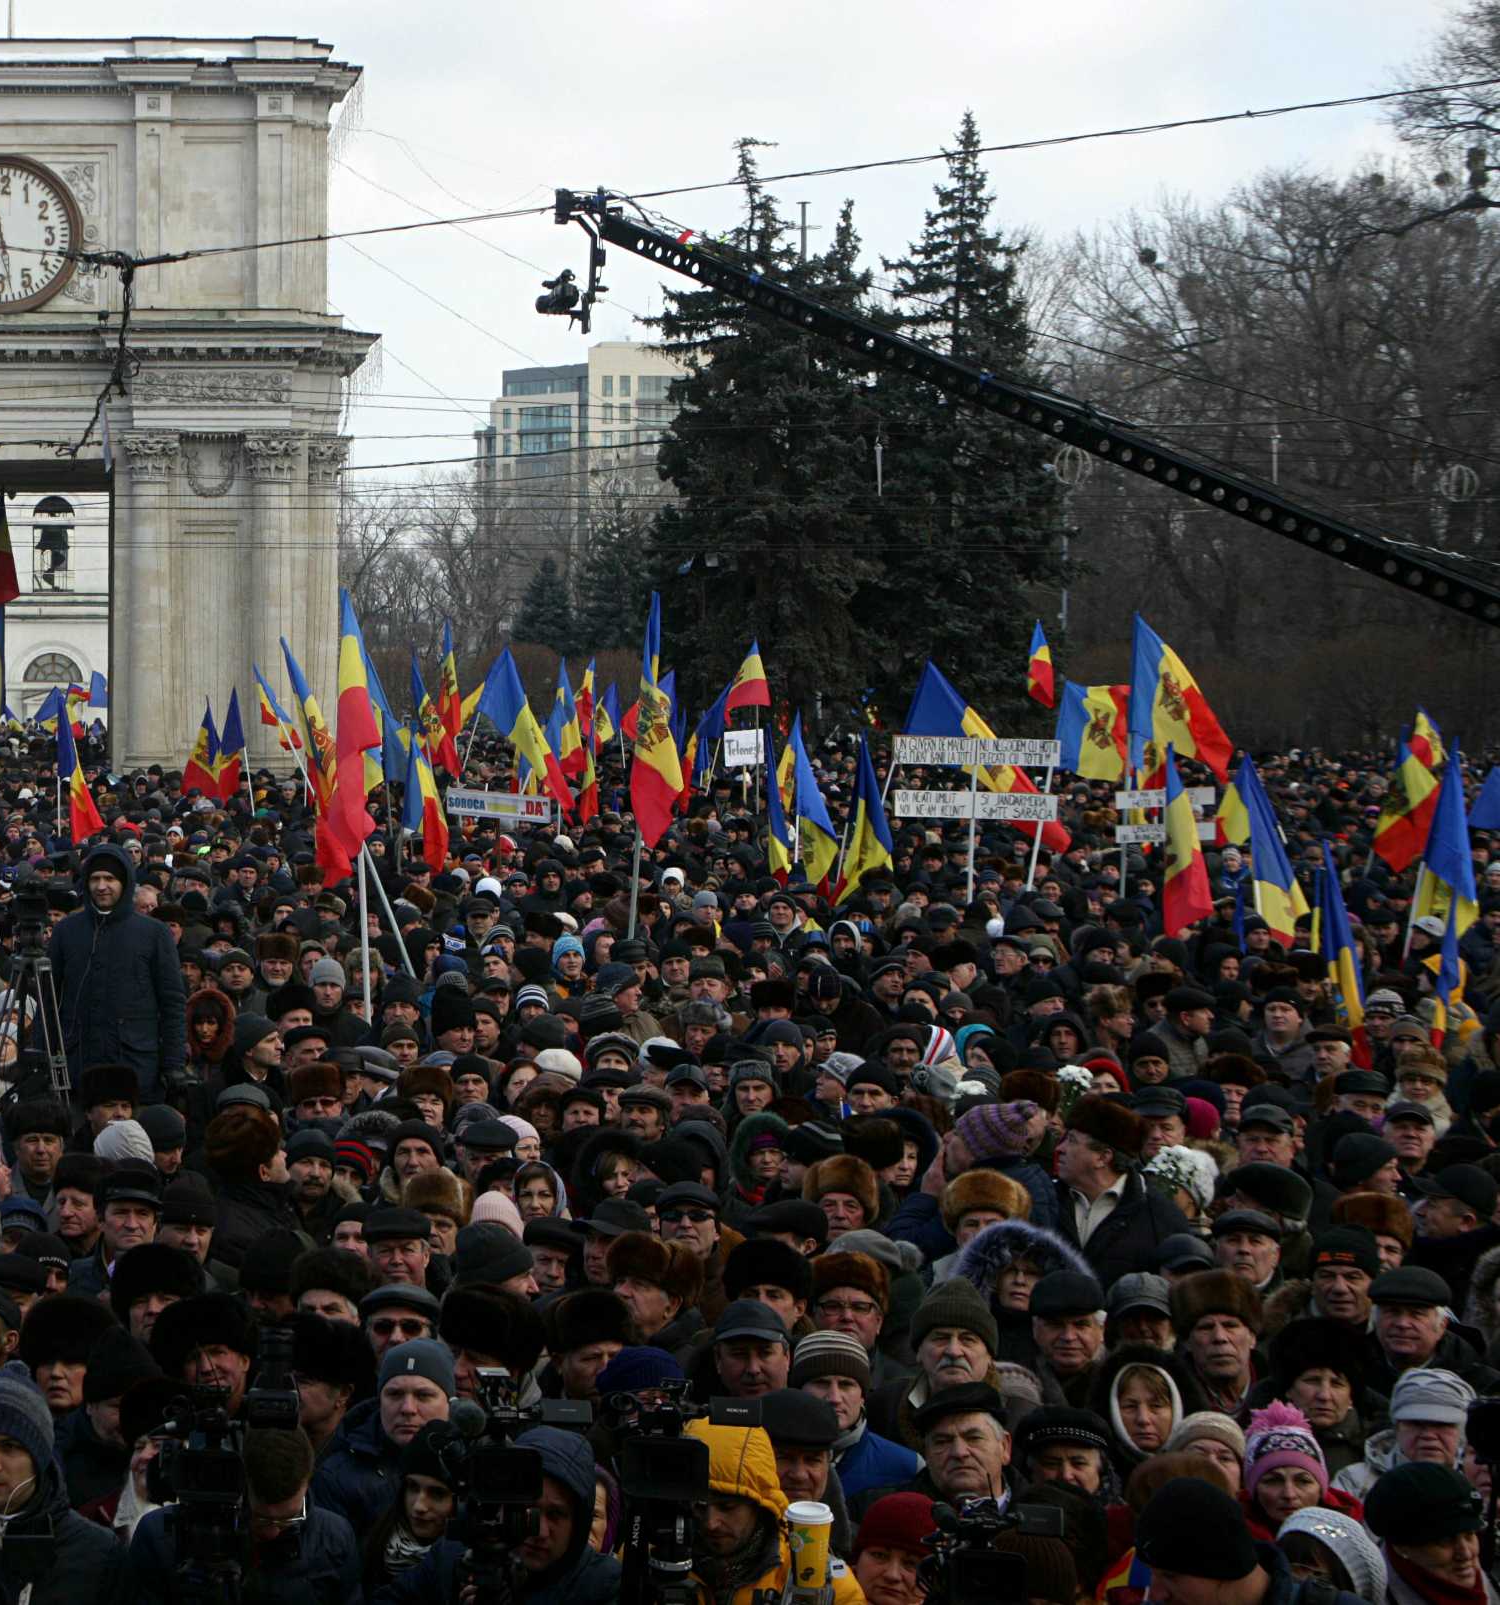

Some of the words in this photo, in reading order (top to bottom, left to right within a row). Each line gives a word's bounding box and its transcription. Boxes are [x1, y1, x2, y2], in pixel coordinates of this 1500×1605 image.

[22, 184, 29, 203] 1
[38, 200, 49, 220] 2
[45, 226, 55, 246] 3
[40, 251, 51, 271] 4
[21, 268, 32, 288] 5
[448, 797, 486, 810] SOROCA
[631, 1515, 642, 1547] SONY
